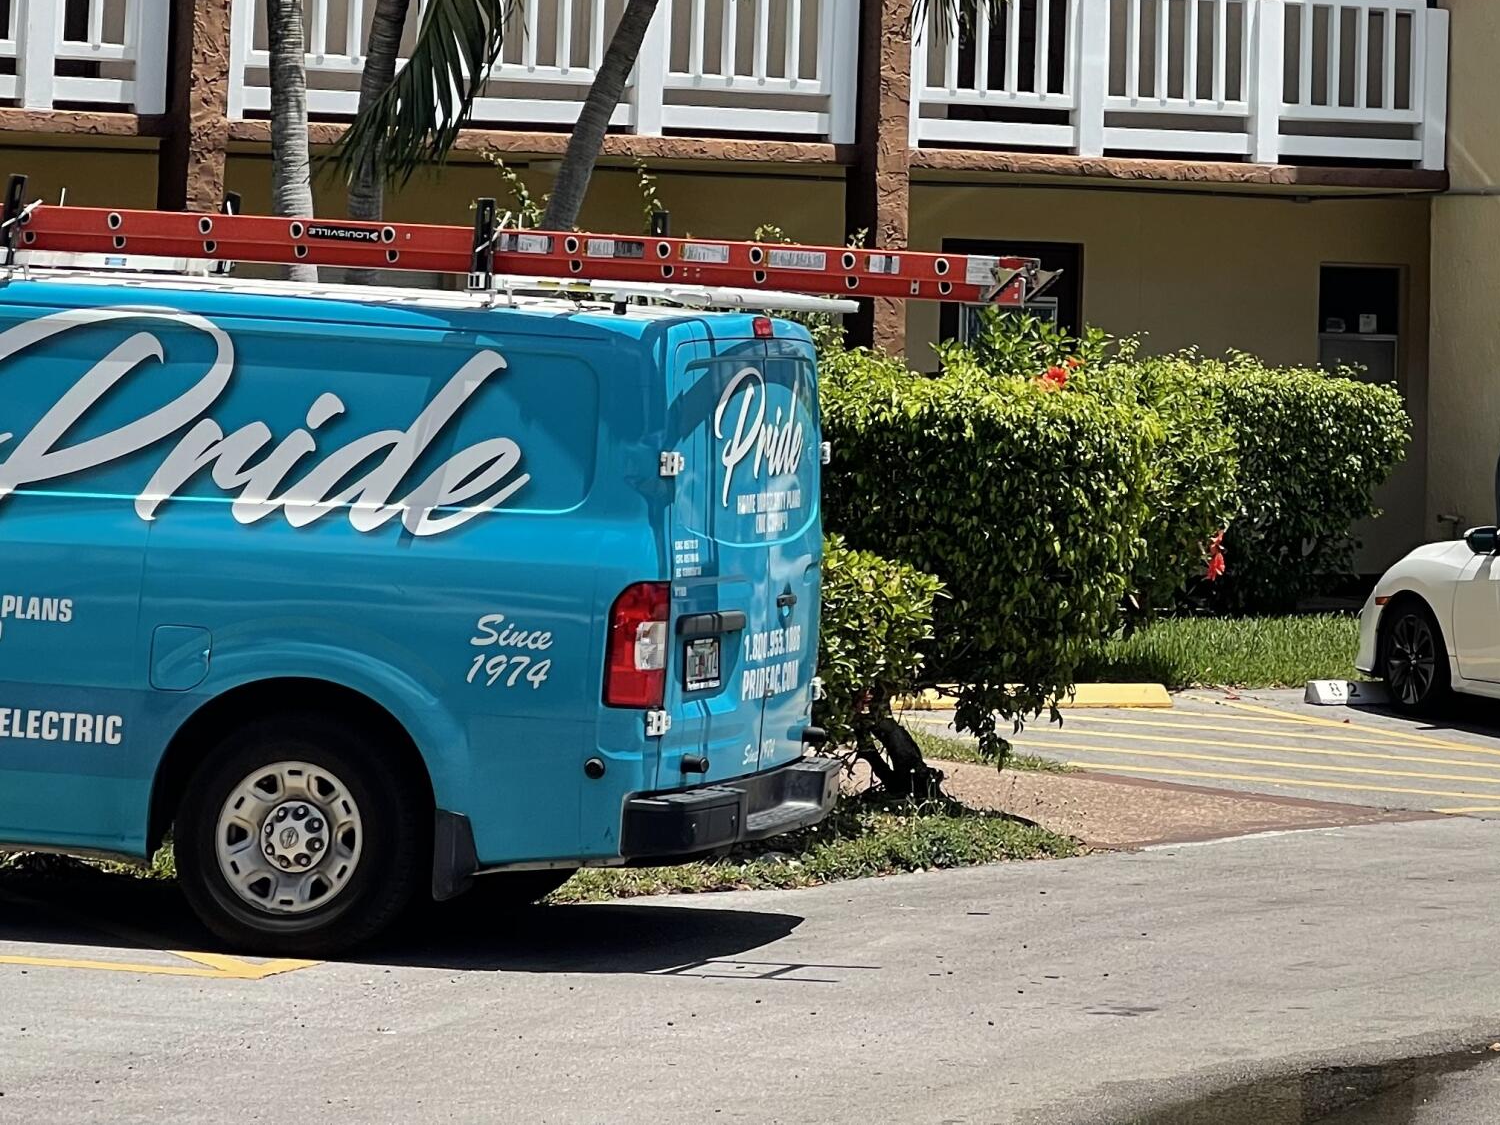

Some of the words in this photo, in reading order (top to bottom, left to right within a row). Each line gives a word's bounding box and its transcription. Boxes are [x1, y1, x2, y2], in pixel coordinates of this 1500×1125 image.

[308, 227, 370, 239] LOUISVILLE
[0, 305, 531, 536] Pride
[714, 366, 803, 507] Pride
[1, 594, 73, 623] PLANS
[470, 613, 553, 650] Since
[466, 654, 551, 689] 1974
[0, 707, 123, 745] ELECTRIC
